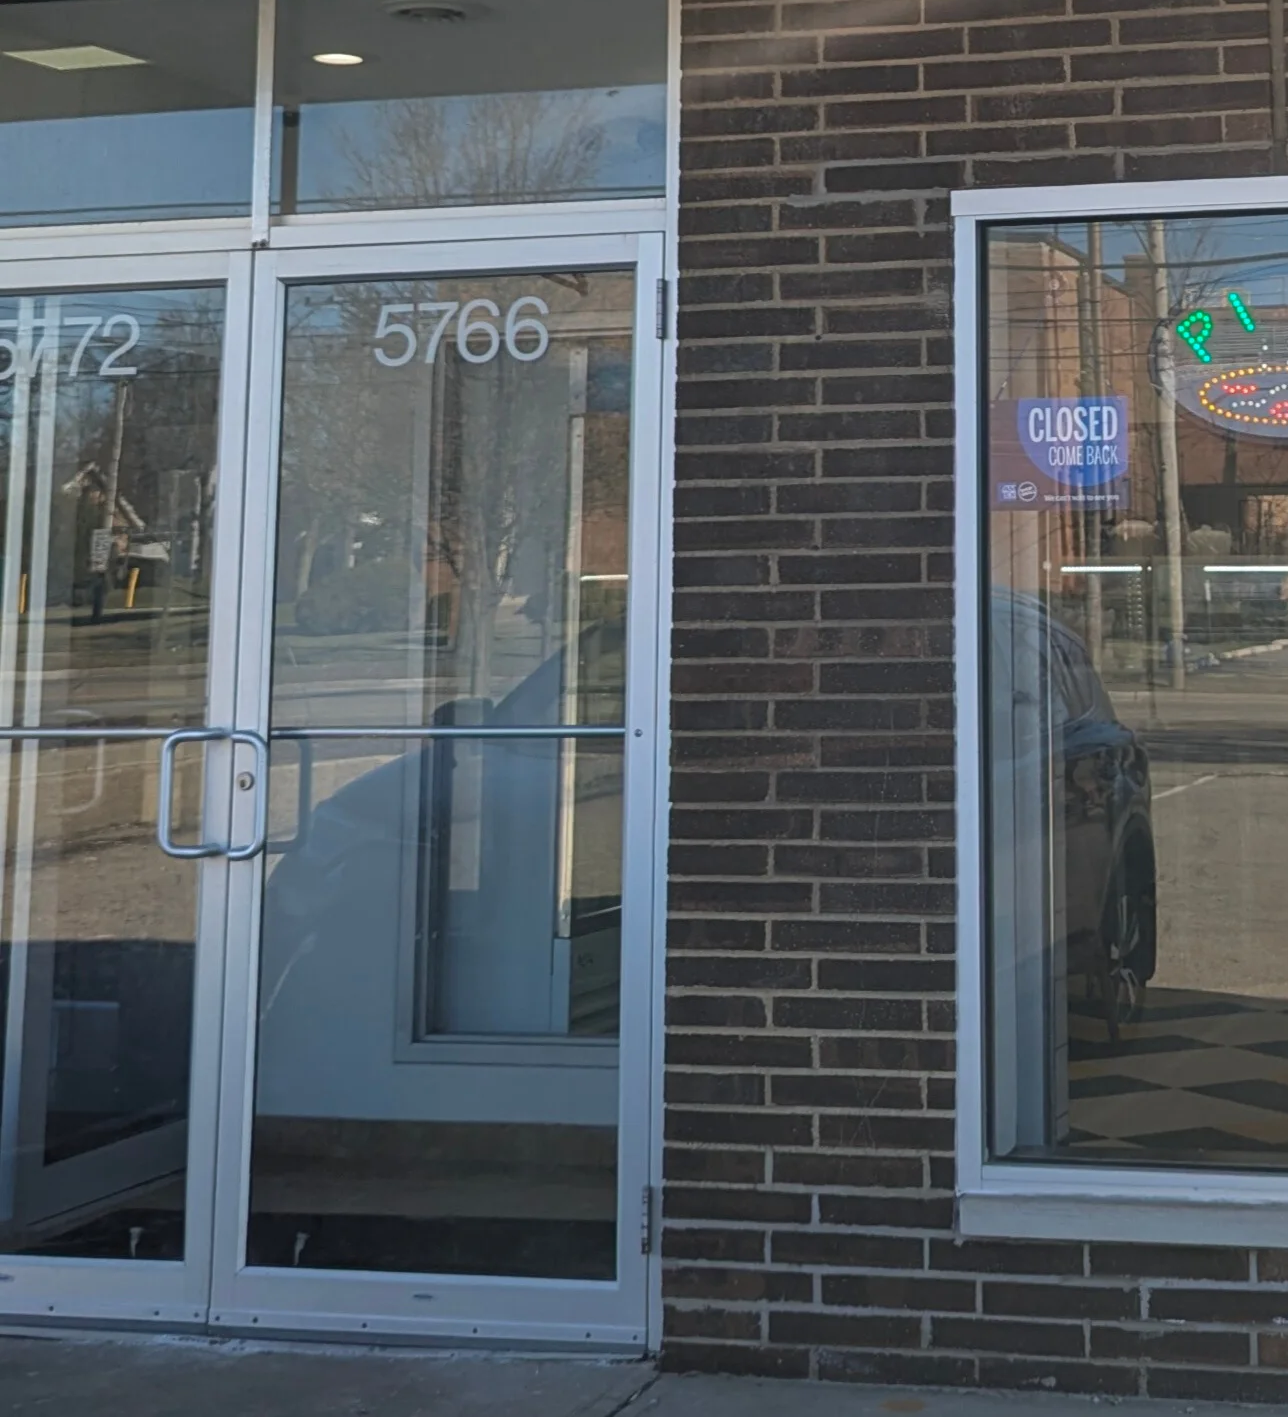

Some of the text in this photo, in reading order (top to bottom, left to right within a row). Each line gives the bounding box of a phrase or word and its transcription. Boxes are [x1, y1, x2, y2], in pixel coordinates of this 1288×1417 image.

[374, 295, 549, 367] 5766
[1028, 406, 1118, 443] CLOSED
[1048, 445, 1119, 466] COME BACK
